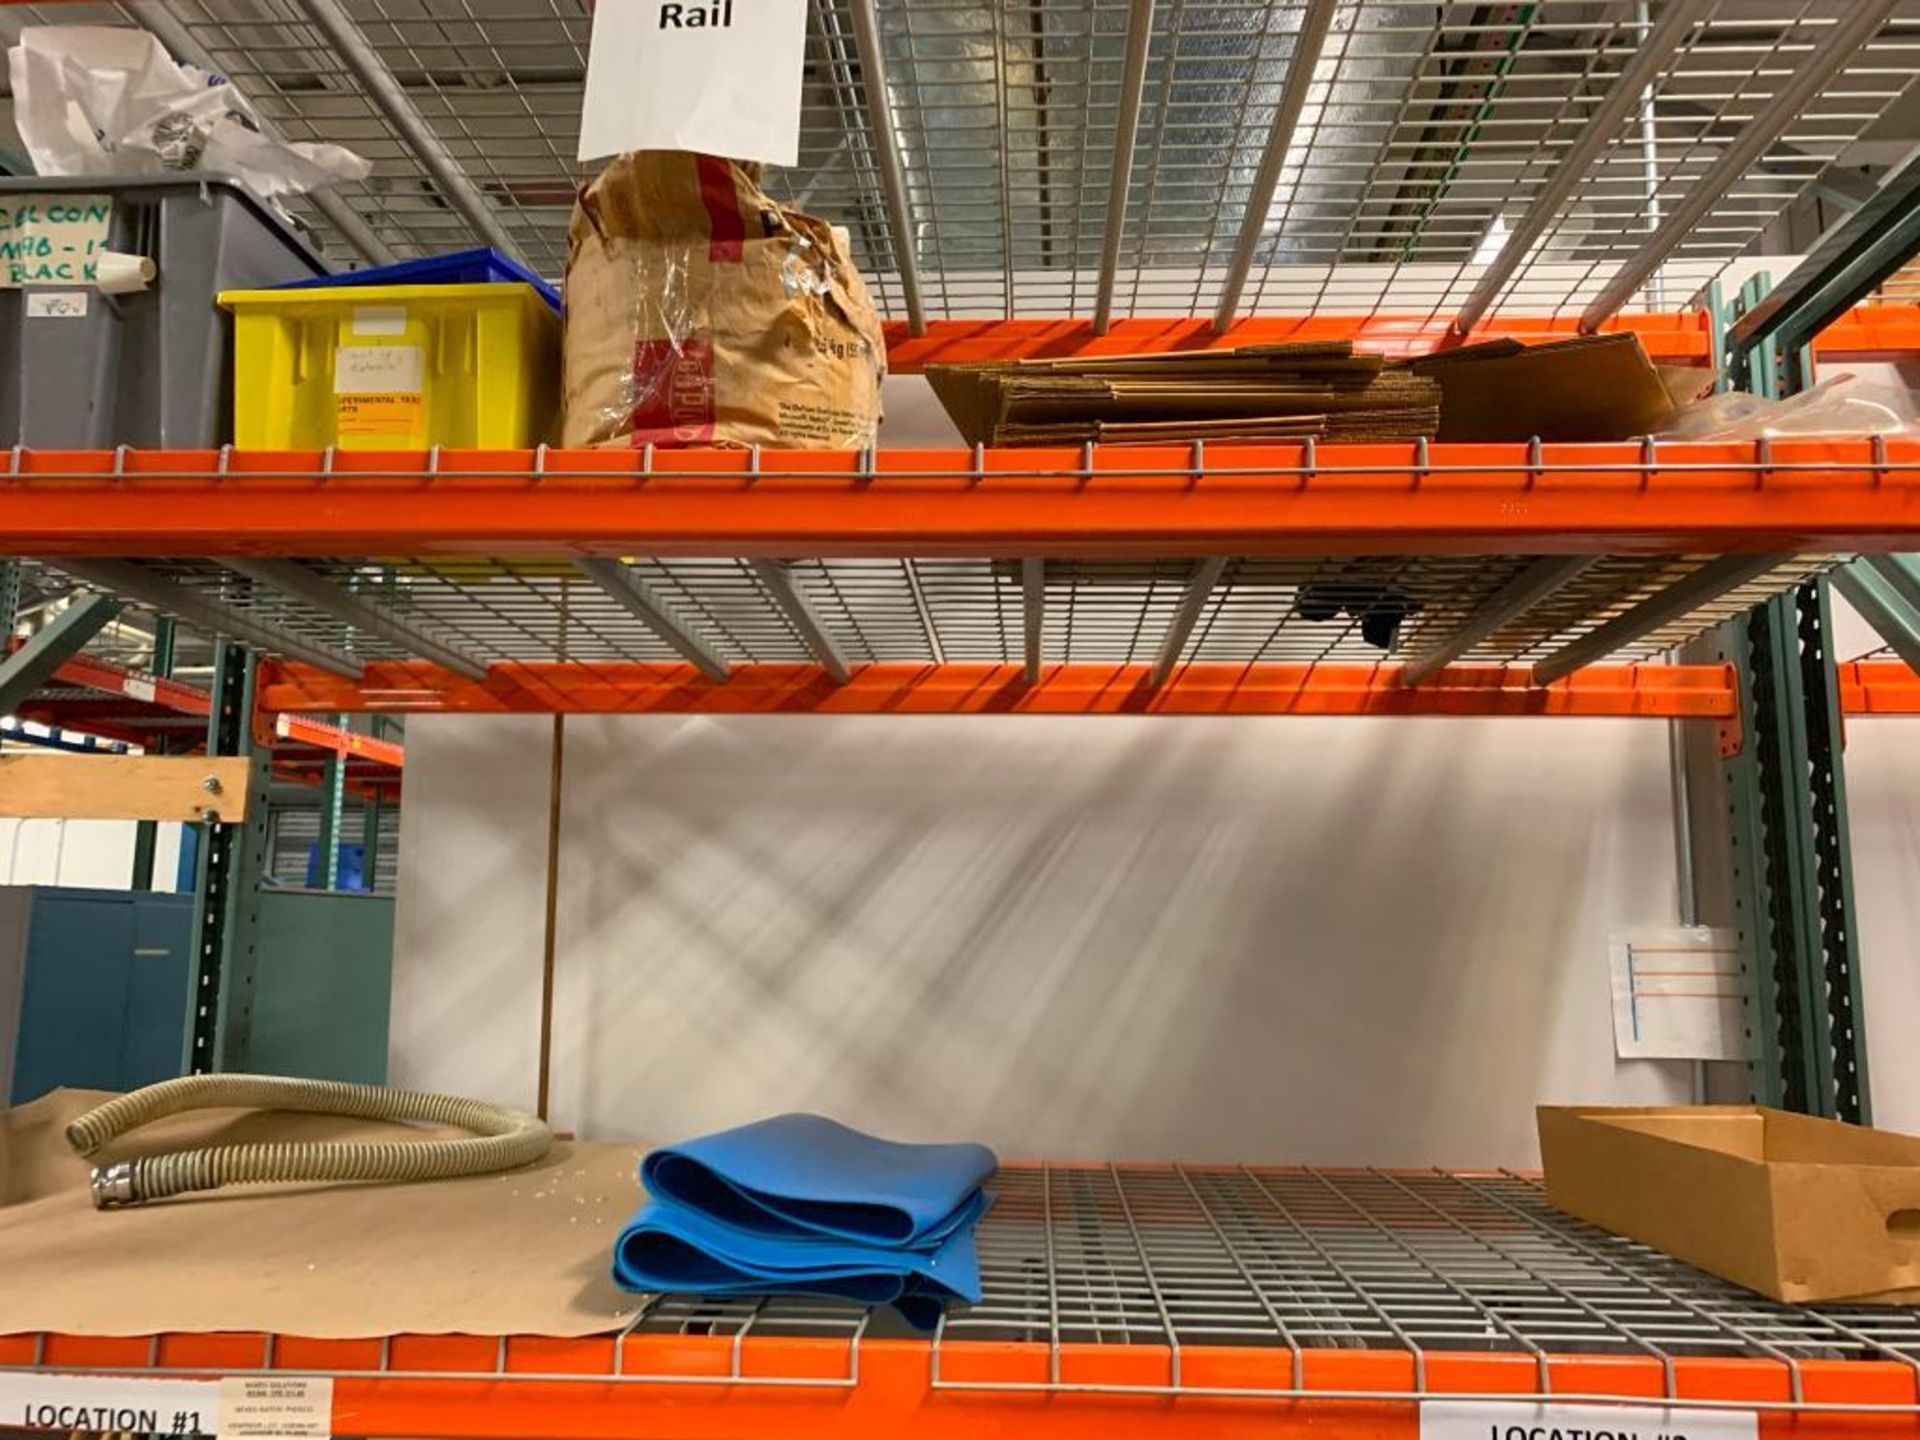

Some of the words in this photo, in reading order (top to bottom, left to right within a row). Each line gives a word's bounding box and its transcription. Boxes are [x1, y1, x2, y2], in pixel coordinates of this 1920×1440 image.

[659, 0, 732, 29] Rail
[9, 262, 97, 283] BLACK
[25, 1404, 157, 1431] LOCATION
[173, 1411, 203, 1434] #1
